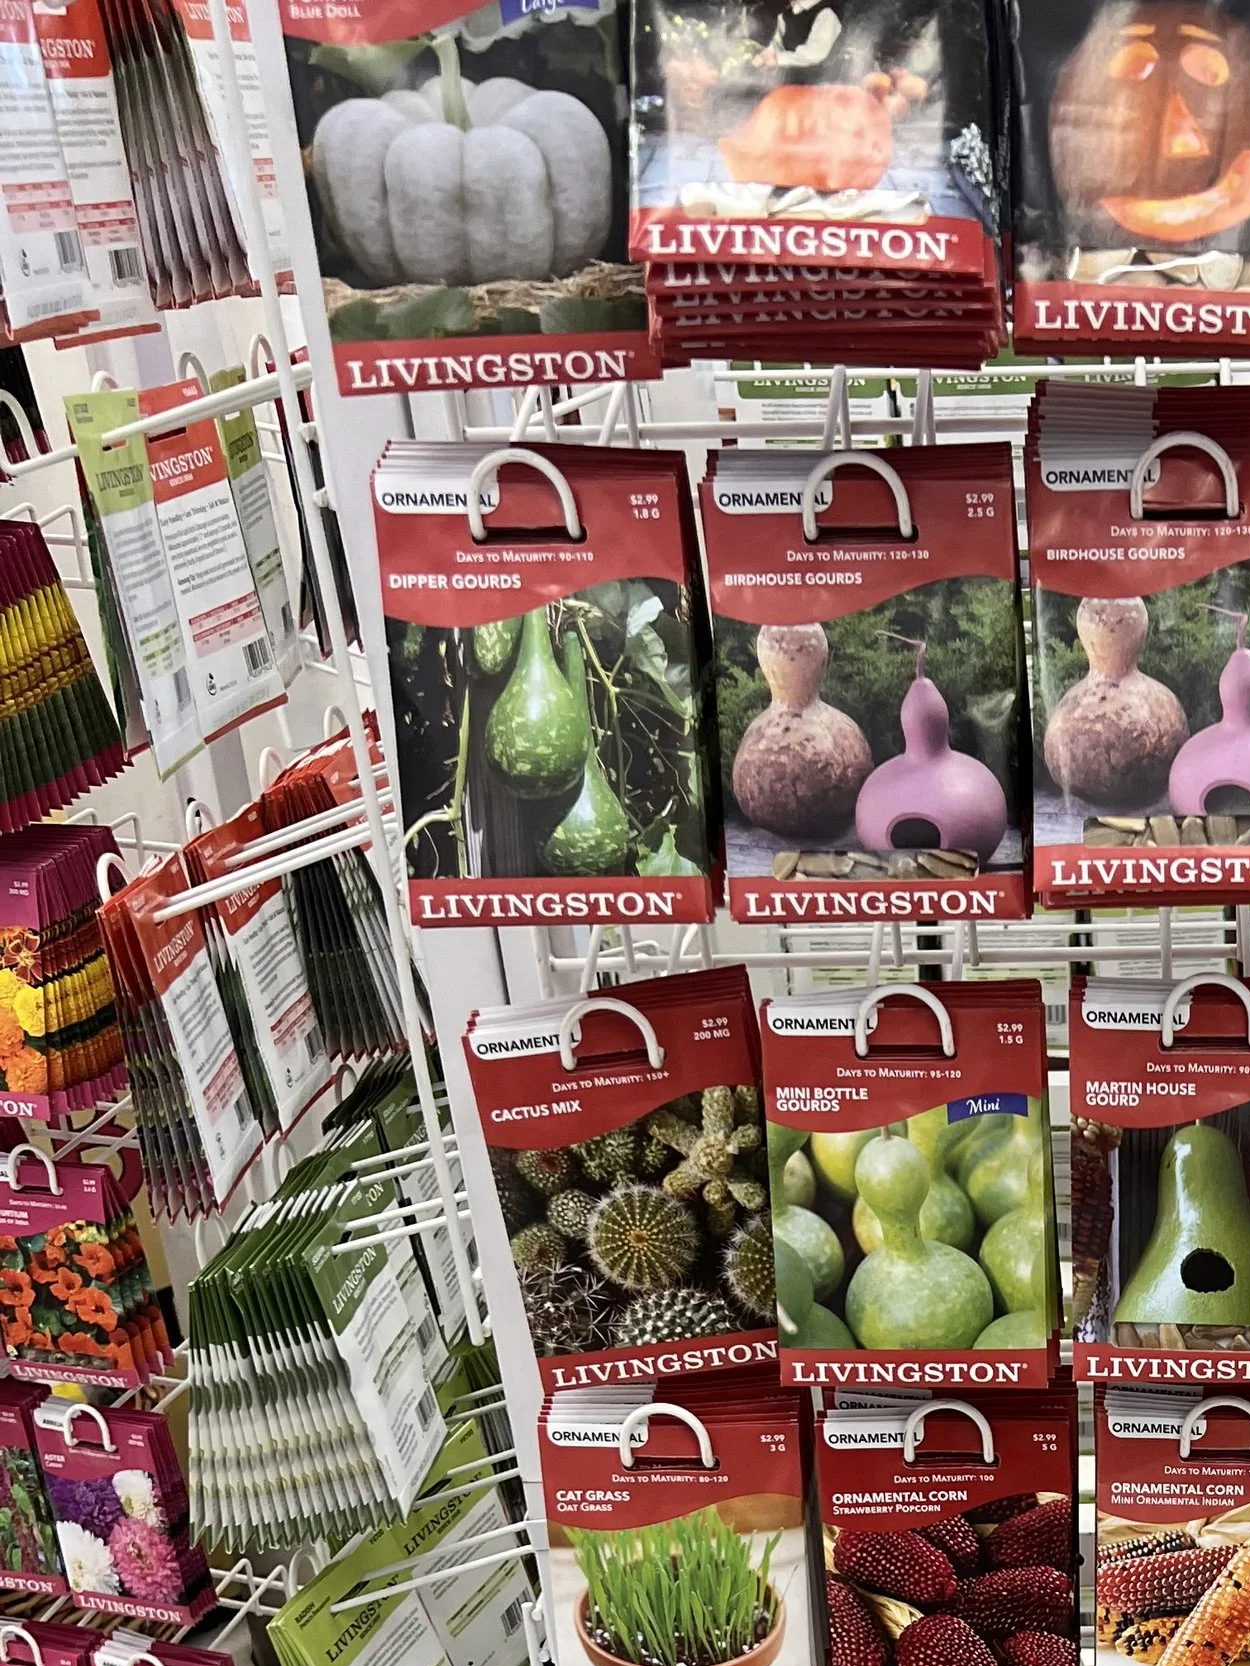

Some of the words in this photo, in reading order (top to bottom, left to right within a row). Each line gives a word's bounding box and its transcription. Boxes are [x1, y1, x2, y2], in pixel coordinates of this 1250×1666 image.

[648, 222, 950, 263] LIVINGSTON
[351, 351, 627, 389] LIVINGSTON
[630, 494, 658, 505] $2.99
[966, 494, 994, 503] $2.99
[1047, 548, 1124, 561] BIRDHOUSE
[1128, 548, 1185, 560] GOURDS
[389, 575, 448, 589] DIPPER
[452, 575, 522, 589] GOURDS
[725, 573, 801, 586] BIRDHOUSE
[805, 573, 862, 585] GOURDS
[418, 890, 674, 920] LIVINGSTON
[745, 889, 998, 918] LIVINGSTON
[702, 1018, 728, 1028] $2.99
[997, 1023, 1023, 1033] $2.99
[694, 1031, 710, 1041] 200
[713, 1029, 730, 1040] MG
[776, 1088, 811, 1100] MINI
[814, 1087, 868, 1100] BOTTLE
[1086, 1080, 1143, 1095] MARTIN
[1146, 1082, 1196, 1096] HOUSE
[776, 1099, 840, 1112] GOURDS
[966, 1098, 1000, 1115] Mini
[1086, 1093, 1139, 1107] GOURD
[491, 1103, 549, 1123] CACTUS
[552, 1100, 582, 1115] MIX
[553, 1338, 778, 1387] LIVINGSTON
[14, 1365, 127, 1388] LIVINGSTON
[792, 1361, 1022, 1384] LIVINGSTON
[761, 1434, 785, 1443] $2.99
[1111, 1483, 1203, 1495] ORNAMENTAL
[1206, 1485, 1244, 1495] CORN
[556, 1491, 584, 1501] CAT
[586, 1491, 630, 1501] GRASS
[832, 1492, 926, 1504] ORNAMENTAL
[929, 1491, 967, 1501] CORN
[79, 1596, 180, 1622] LIVINGSTON
